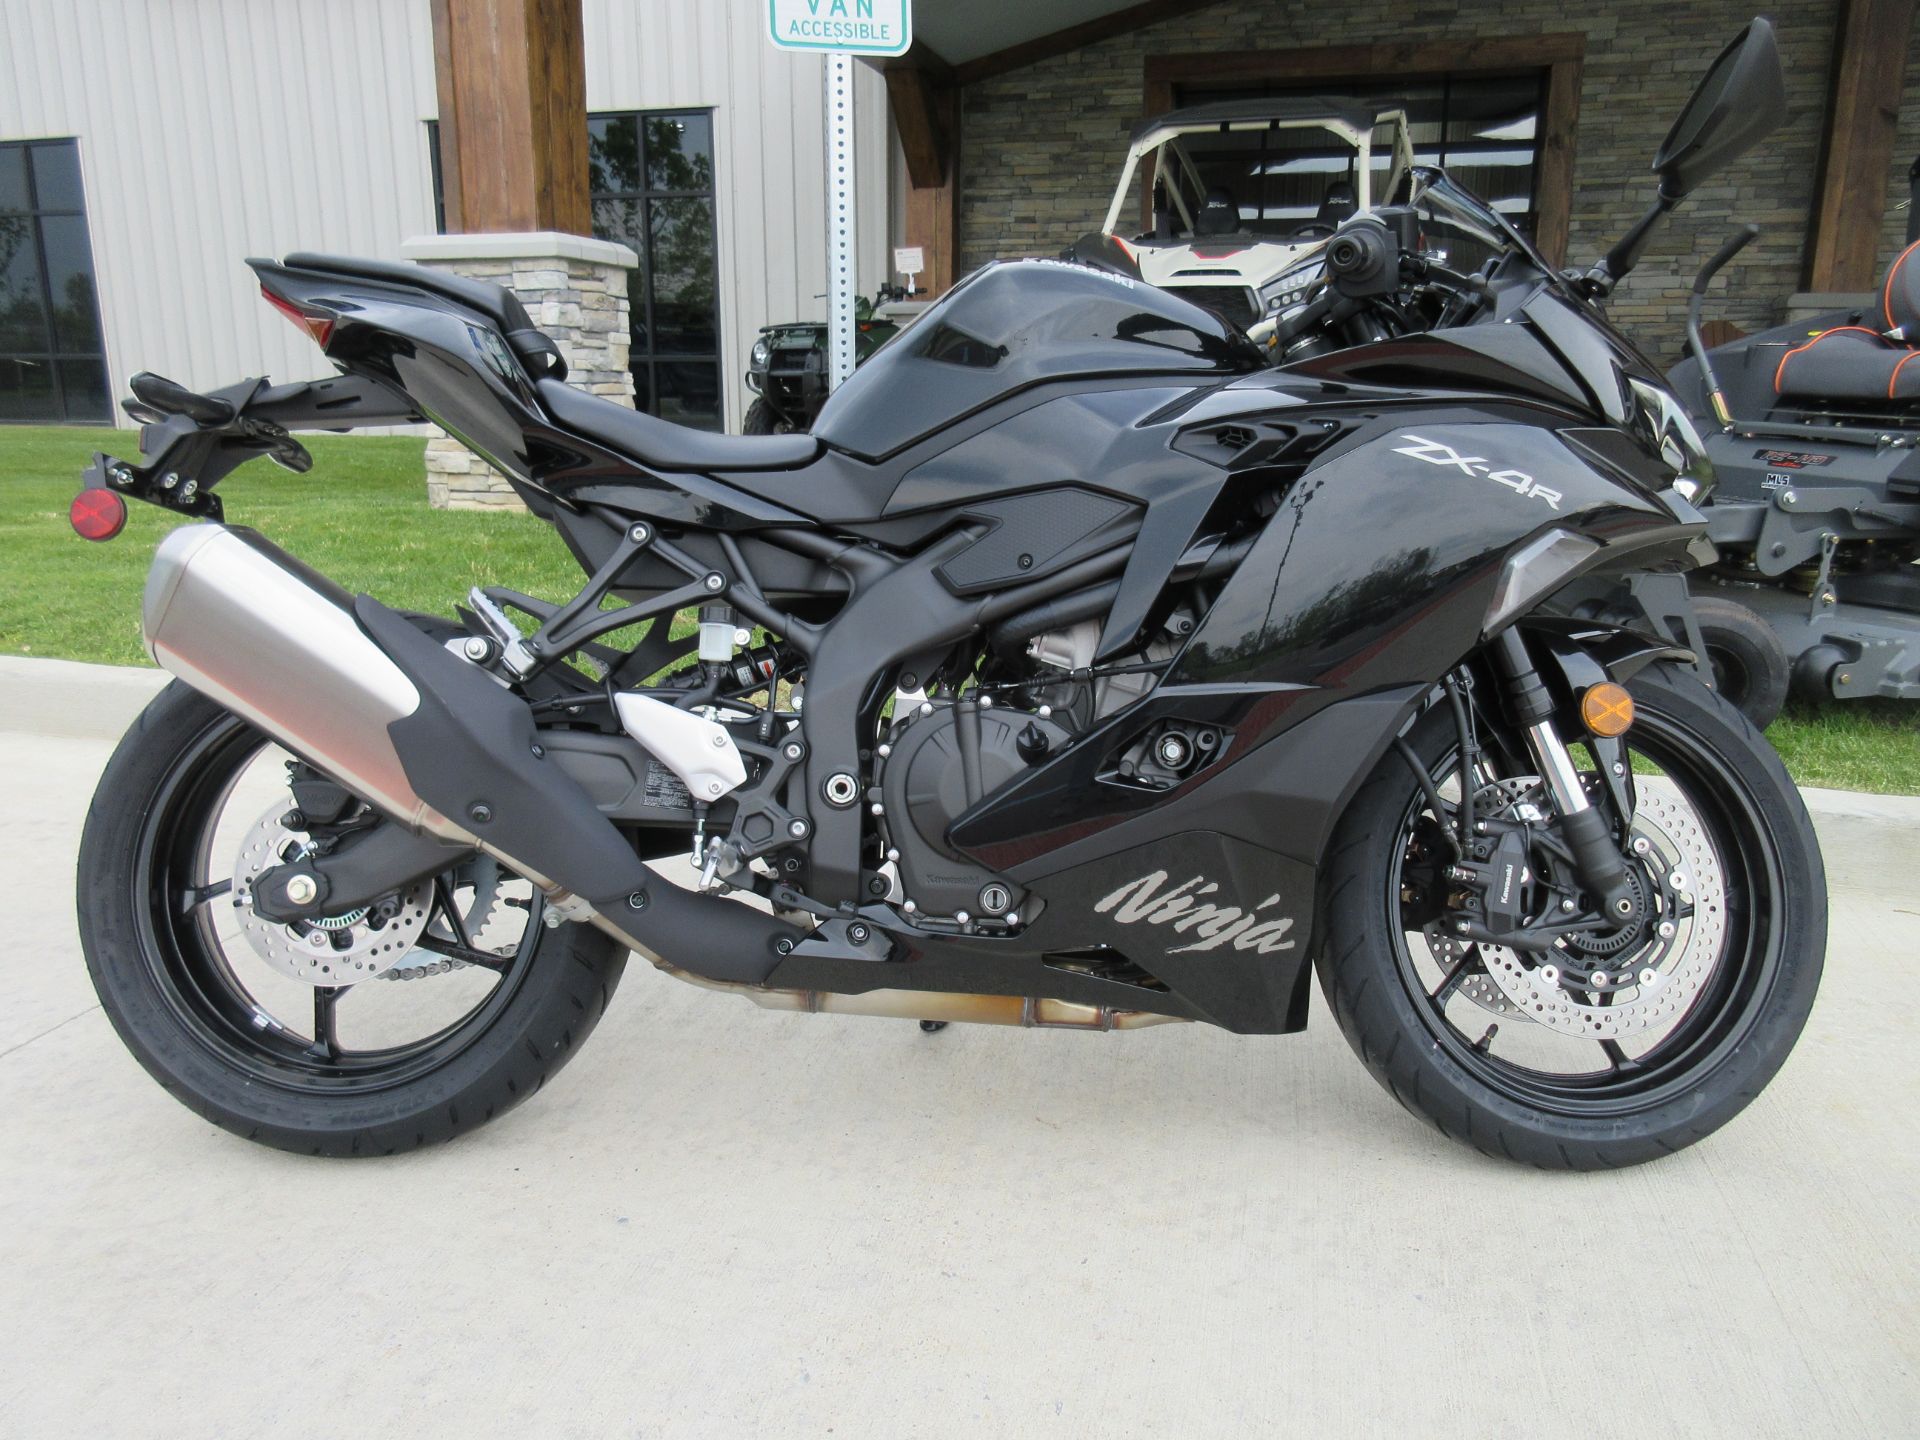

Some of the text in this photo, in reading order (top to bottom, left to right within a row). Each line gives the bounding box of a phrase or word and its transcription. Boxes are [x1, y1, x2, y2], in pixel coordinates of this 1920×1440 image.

[807, 0, 873, 17] VAN
[790, 20, 889, 40] ACCESSIBLE
[1390, 435, 1563, 511] ZX-4R
[1767, 474, 1789, 485] MLS
[1500, 864, 1514, 904] Kawasaki
[1094, 870, 1296, 954] Ninja
